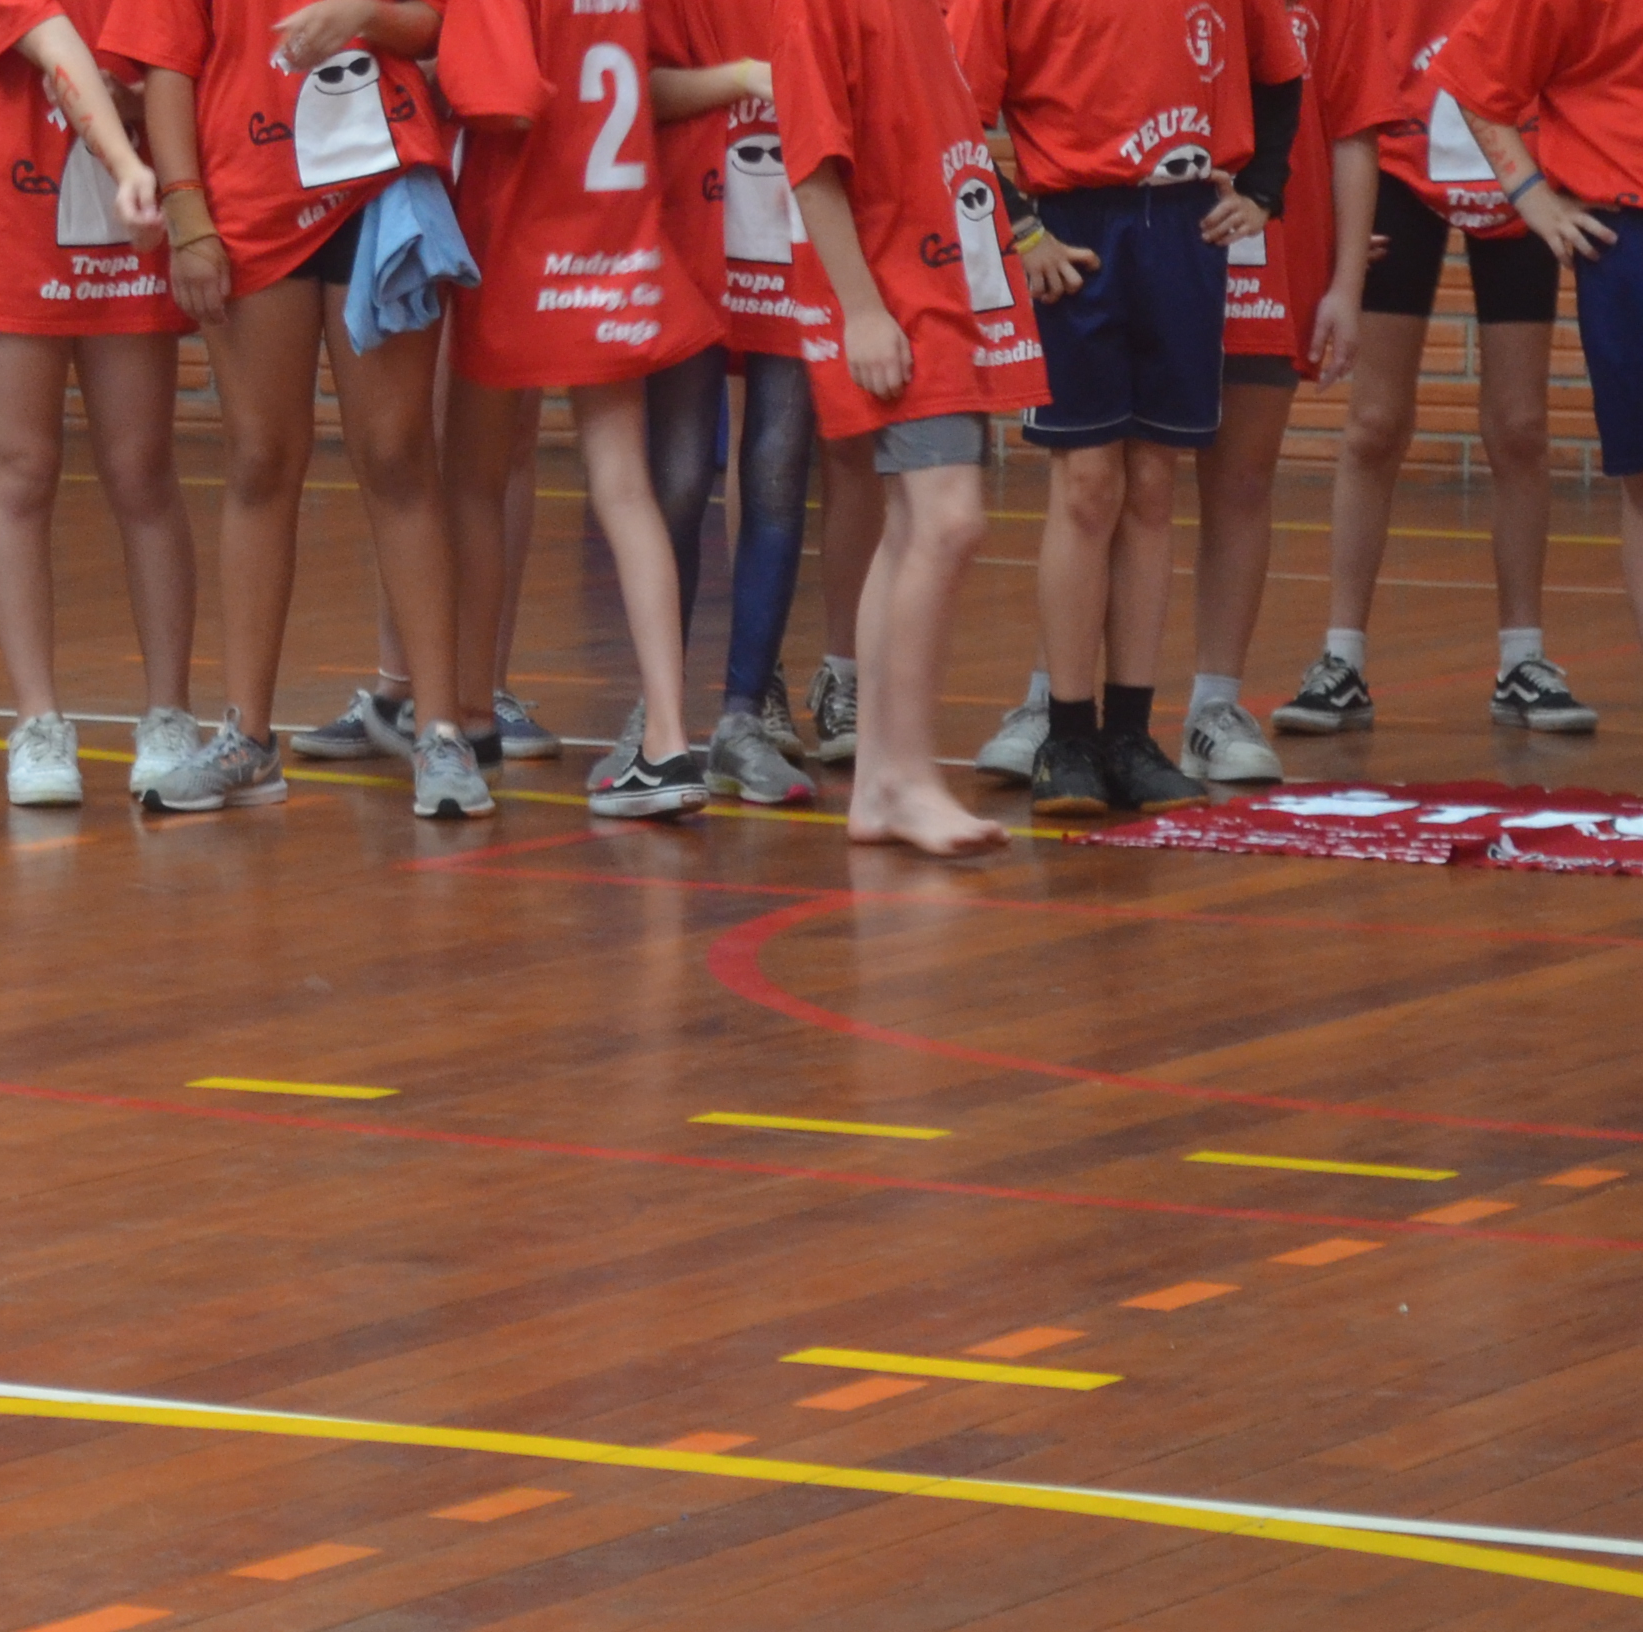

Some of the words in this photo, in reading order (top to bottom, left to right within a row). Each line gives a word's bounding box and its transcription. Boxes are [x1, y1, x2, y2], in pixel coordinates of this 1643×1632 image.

[579, 41, 648, 193] 2
[71, 254, 140, 277] Tropa
[40, 278, 71, 300] da
[76, 274, 168, 301] Ousadia
[726, 270, 785, 294] ropa
